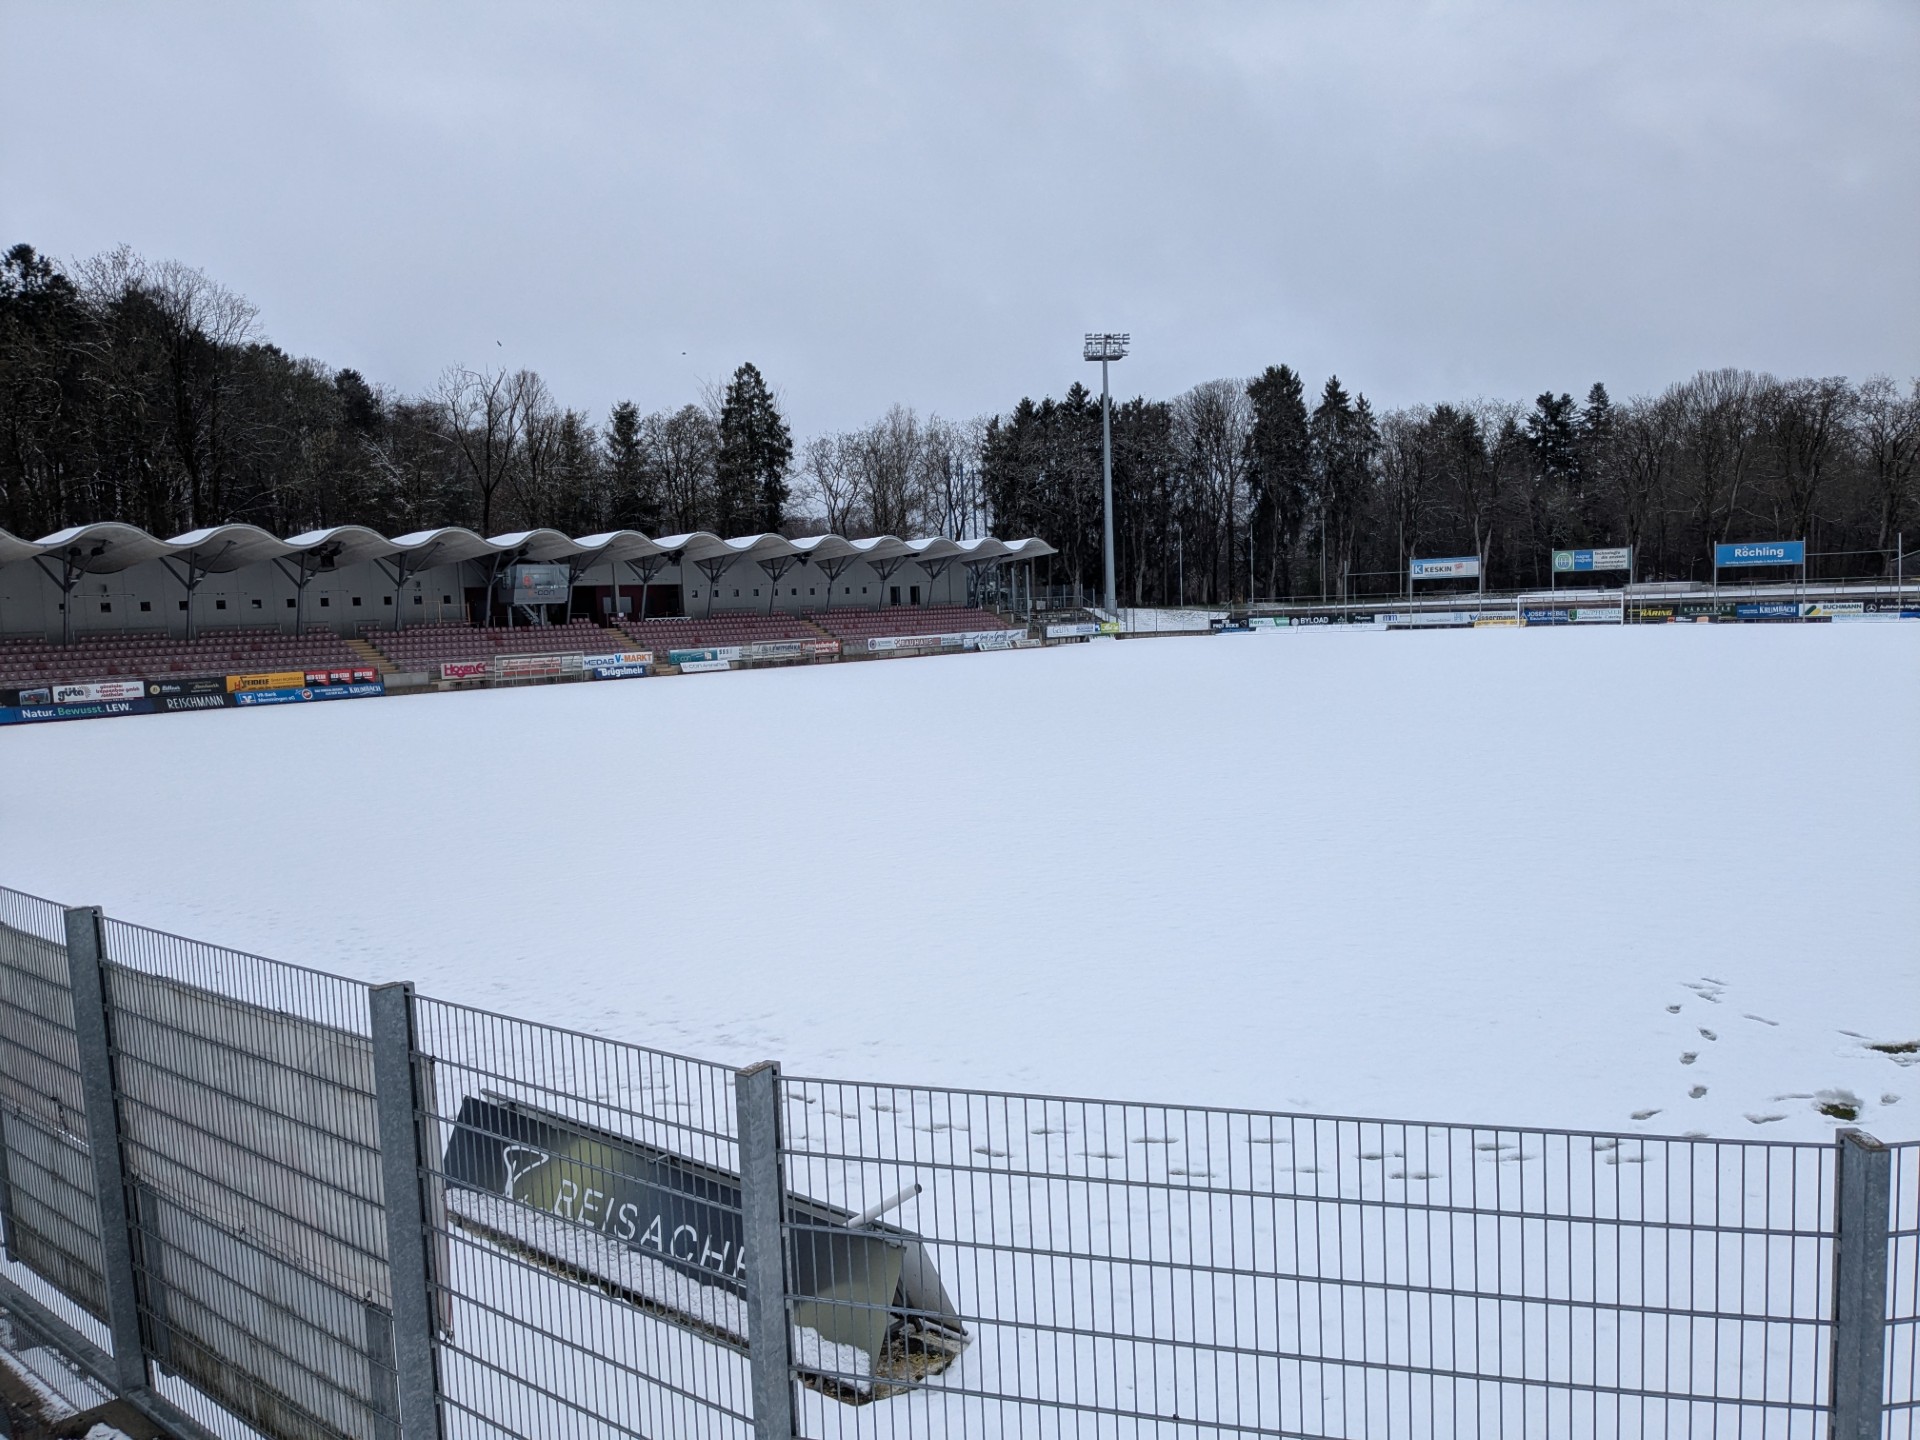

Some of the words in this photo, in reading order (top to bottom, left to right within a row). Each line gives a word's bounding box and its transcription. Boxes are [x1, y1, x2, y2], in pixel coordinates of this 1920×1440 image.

[1734, 546, 1784, 557] Röchling
[1759, 605, 1796, 614] KRUMBACH
[1300, 616, 1329, 624] BYLOAD
[583, 658, 615, 666] MEDAG
[614, 653, 652, 664] V-MARKT
[348, 685, 382, 694] KRUMBACH
[166, 694, 225, 709] REISCHMANN
[22, 709, 56, 719] Natur.
[57, 705, 105, 716] Bewusst.
[106, 702, 133, 713] LEW.
